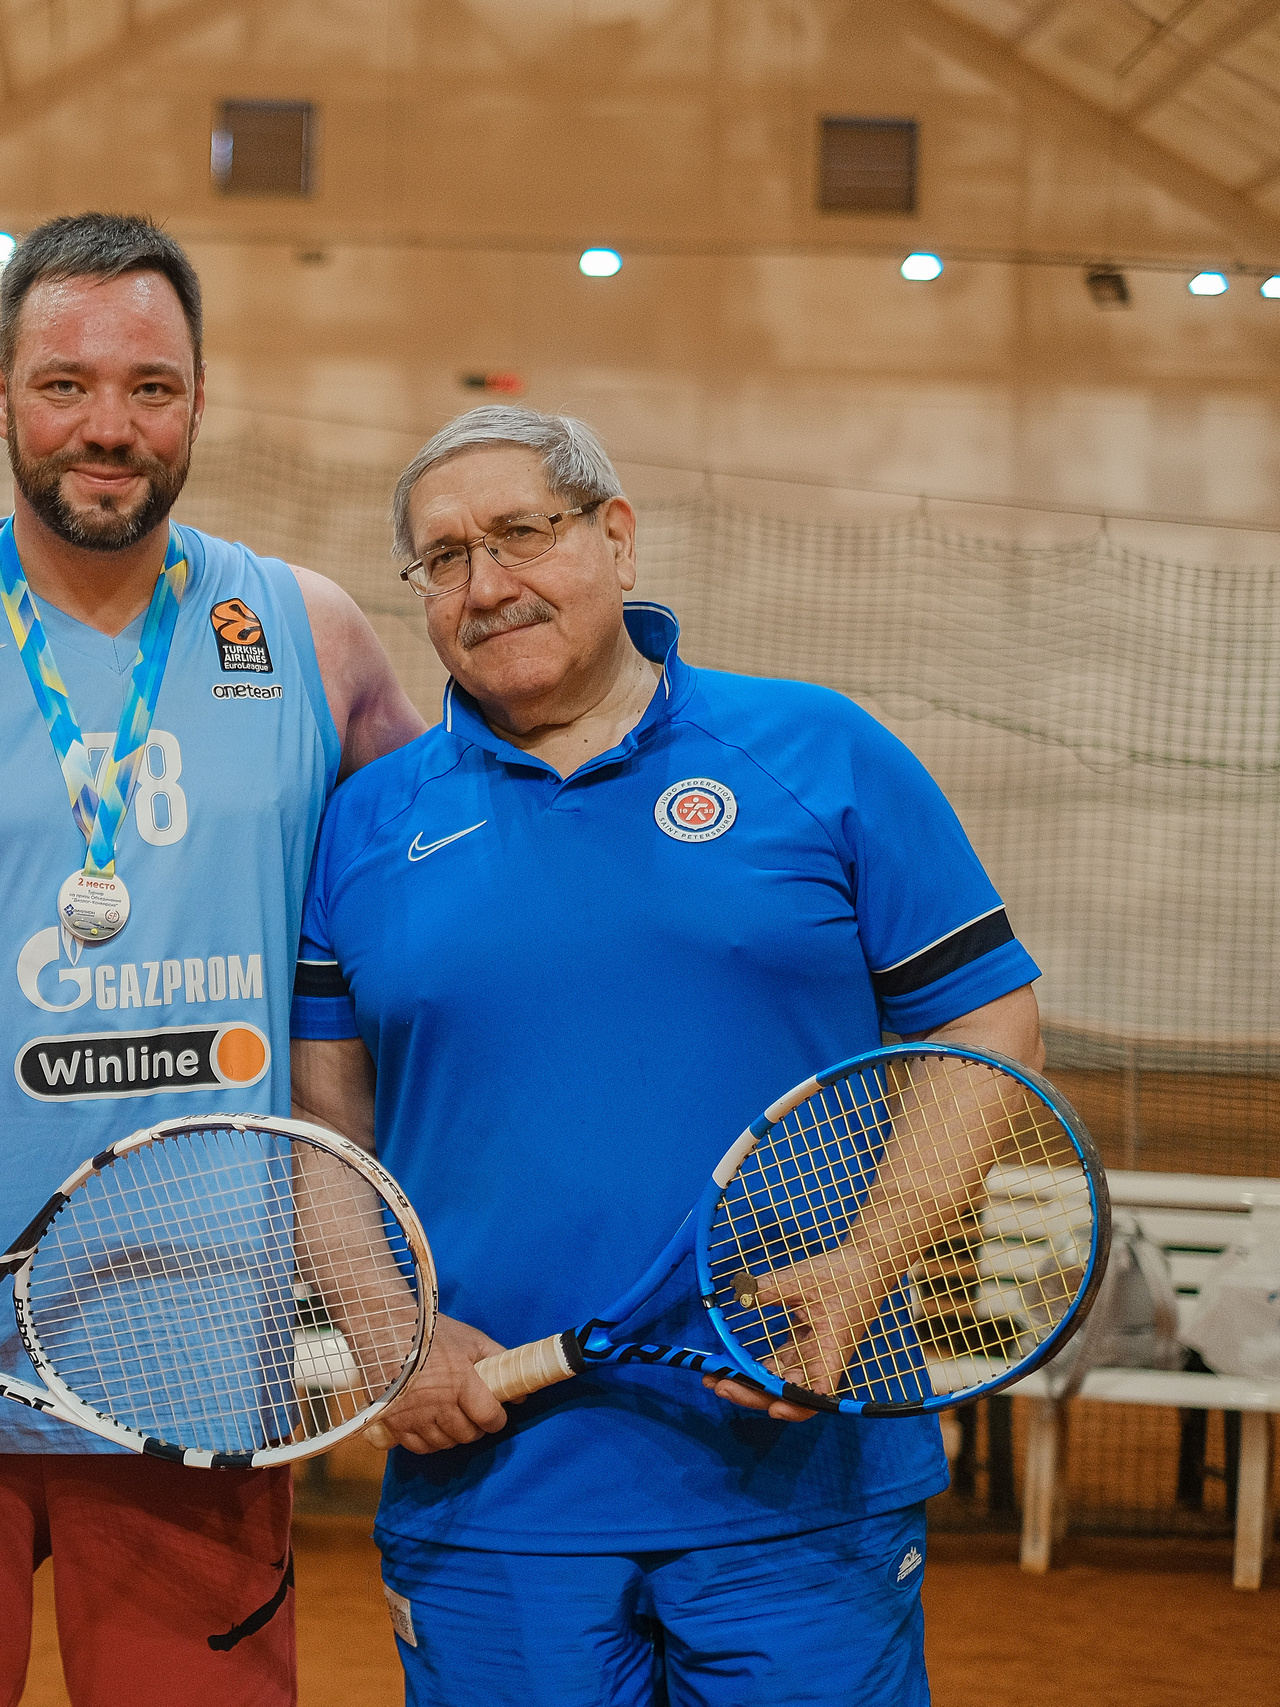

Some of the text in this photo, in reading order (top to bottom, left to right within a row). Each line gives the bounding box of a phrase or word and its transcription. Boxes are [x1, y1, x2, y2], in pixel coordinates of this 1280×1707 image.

[222, 645, 265, 656] TURKISH
[224, 653, 267, 664] AIRLINES
[224, 662, 269, 672] EuroLeague
[661, 780, 732, 805] JUDO FEDERATION
[659, 814, 733, 840] SAINT PETERSBURG
[77, 877, 116, 891] 2 место
[95, 954, 264, 1011] GAZPROM
[37, 1045, 200, 1086] Winline
